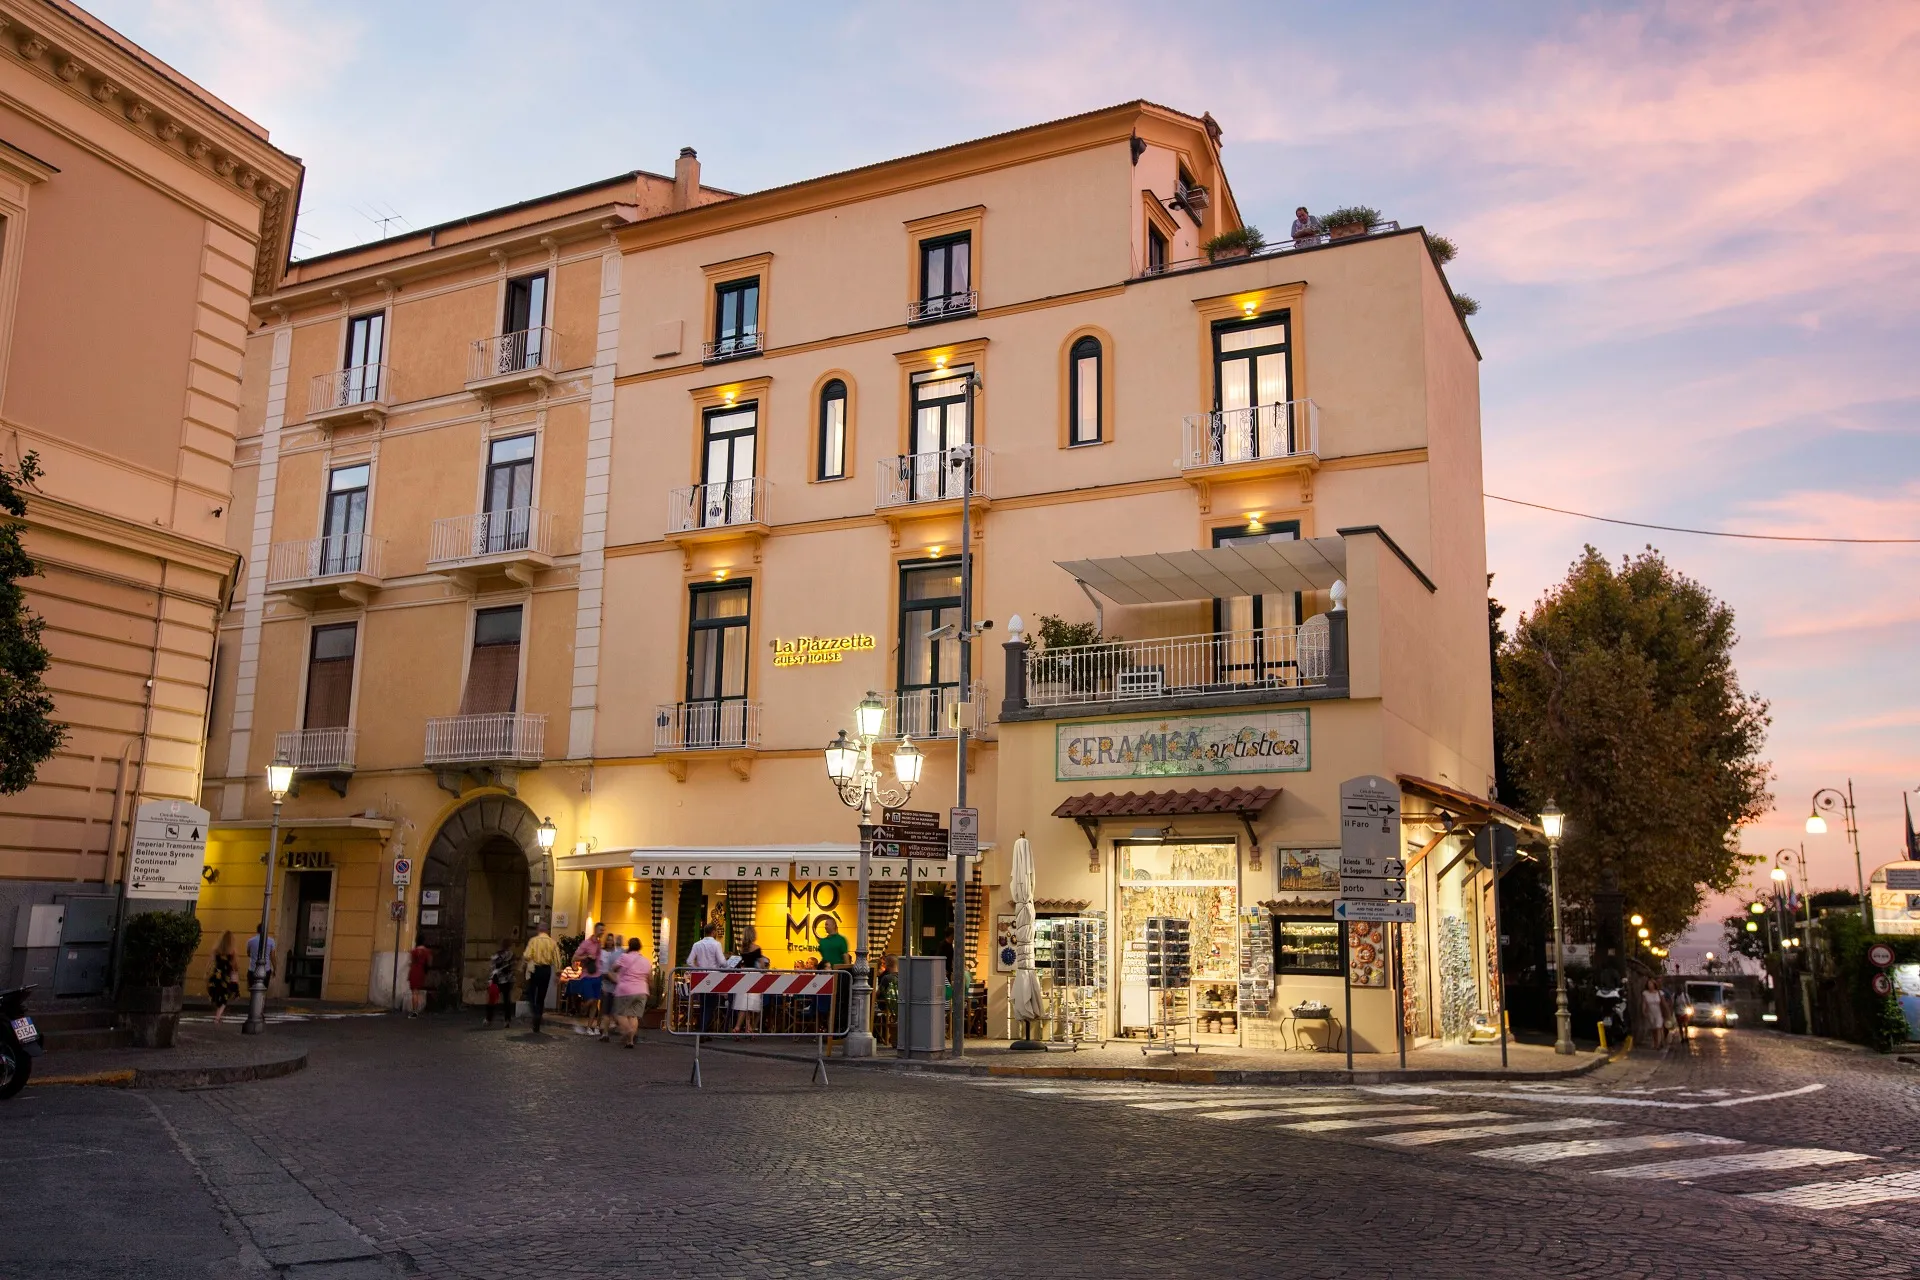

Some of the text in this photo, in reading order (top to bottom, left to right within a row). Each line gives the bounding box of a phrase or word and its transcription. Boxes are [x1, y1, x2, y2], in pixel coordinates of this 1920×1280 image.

[773, 634, 874, 654] La Piazzetta
[773, 652, 841, 664] GUEST HOUSE
[1068, 731, 1300, 766] CERAMICA artistica
[170, 850, 194, 858] Syrene
[641, 866, 780, 877] SNACK BAR
[787, 943, 820, 952] KITCHEN
